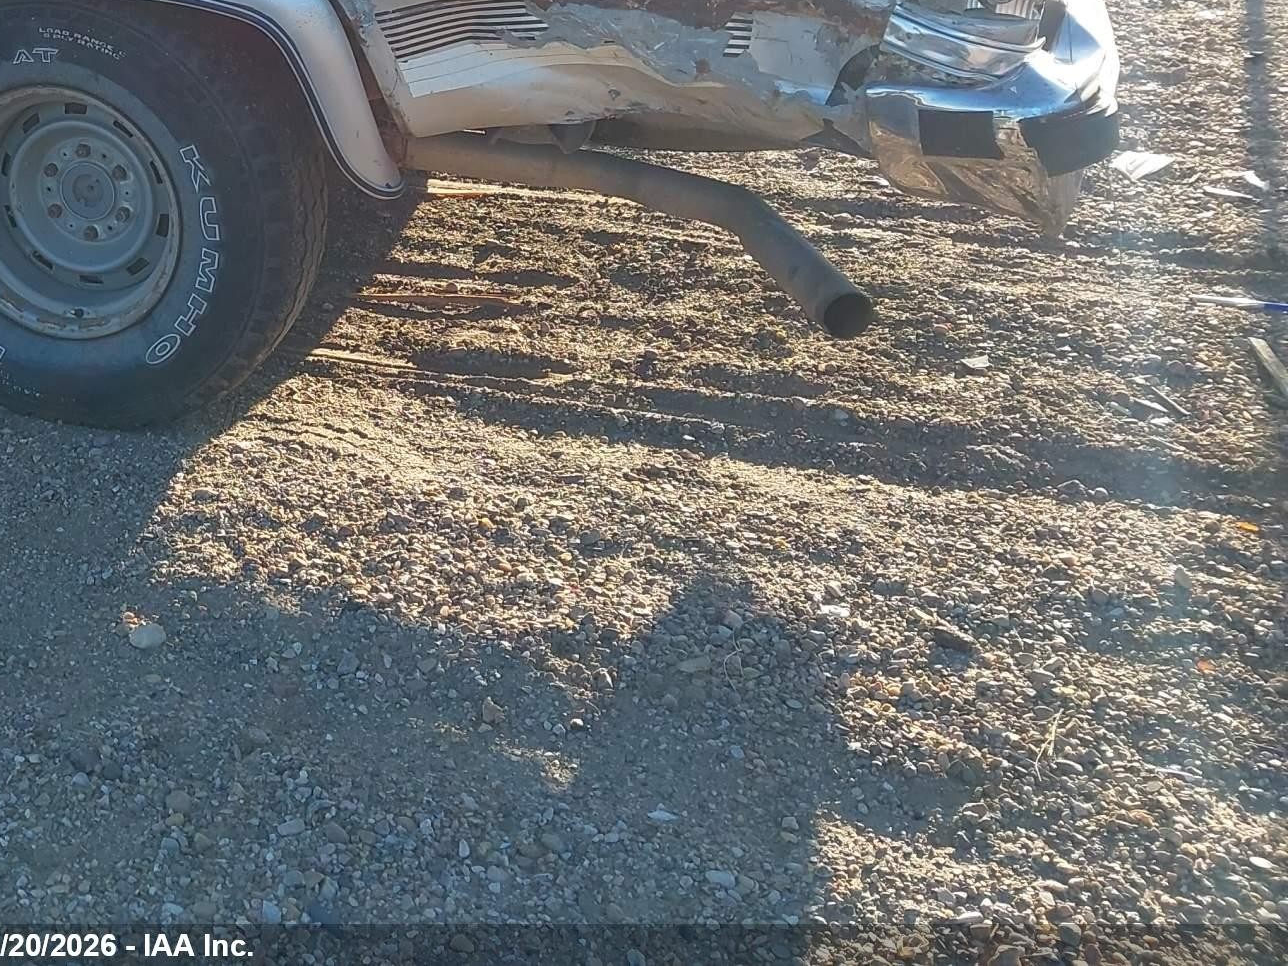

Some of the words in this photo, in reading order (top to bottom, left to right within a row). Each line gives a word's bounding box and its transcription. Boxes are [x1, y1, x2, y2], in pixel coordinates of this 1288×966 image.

[38, 27, 70, 37] LOAD
[13, 47, 59, 65] AT
[145, 144, 221, 366] KUMHO
